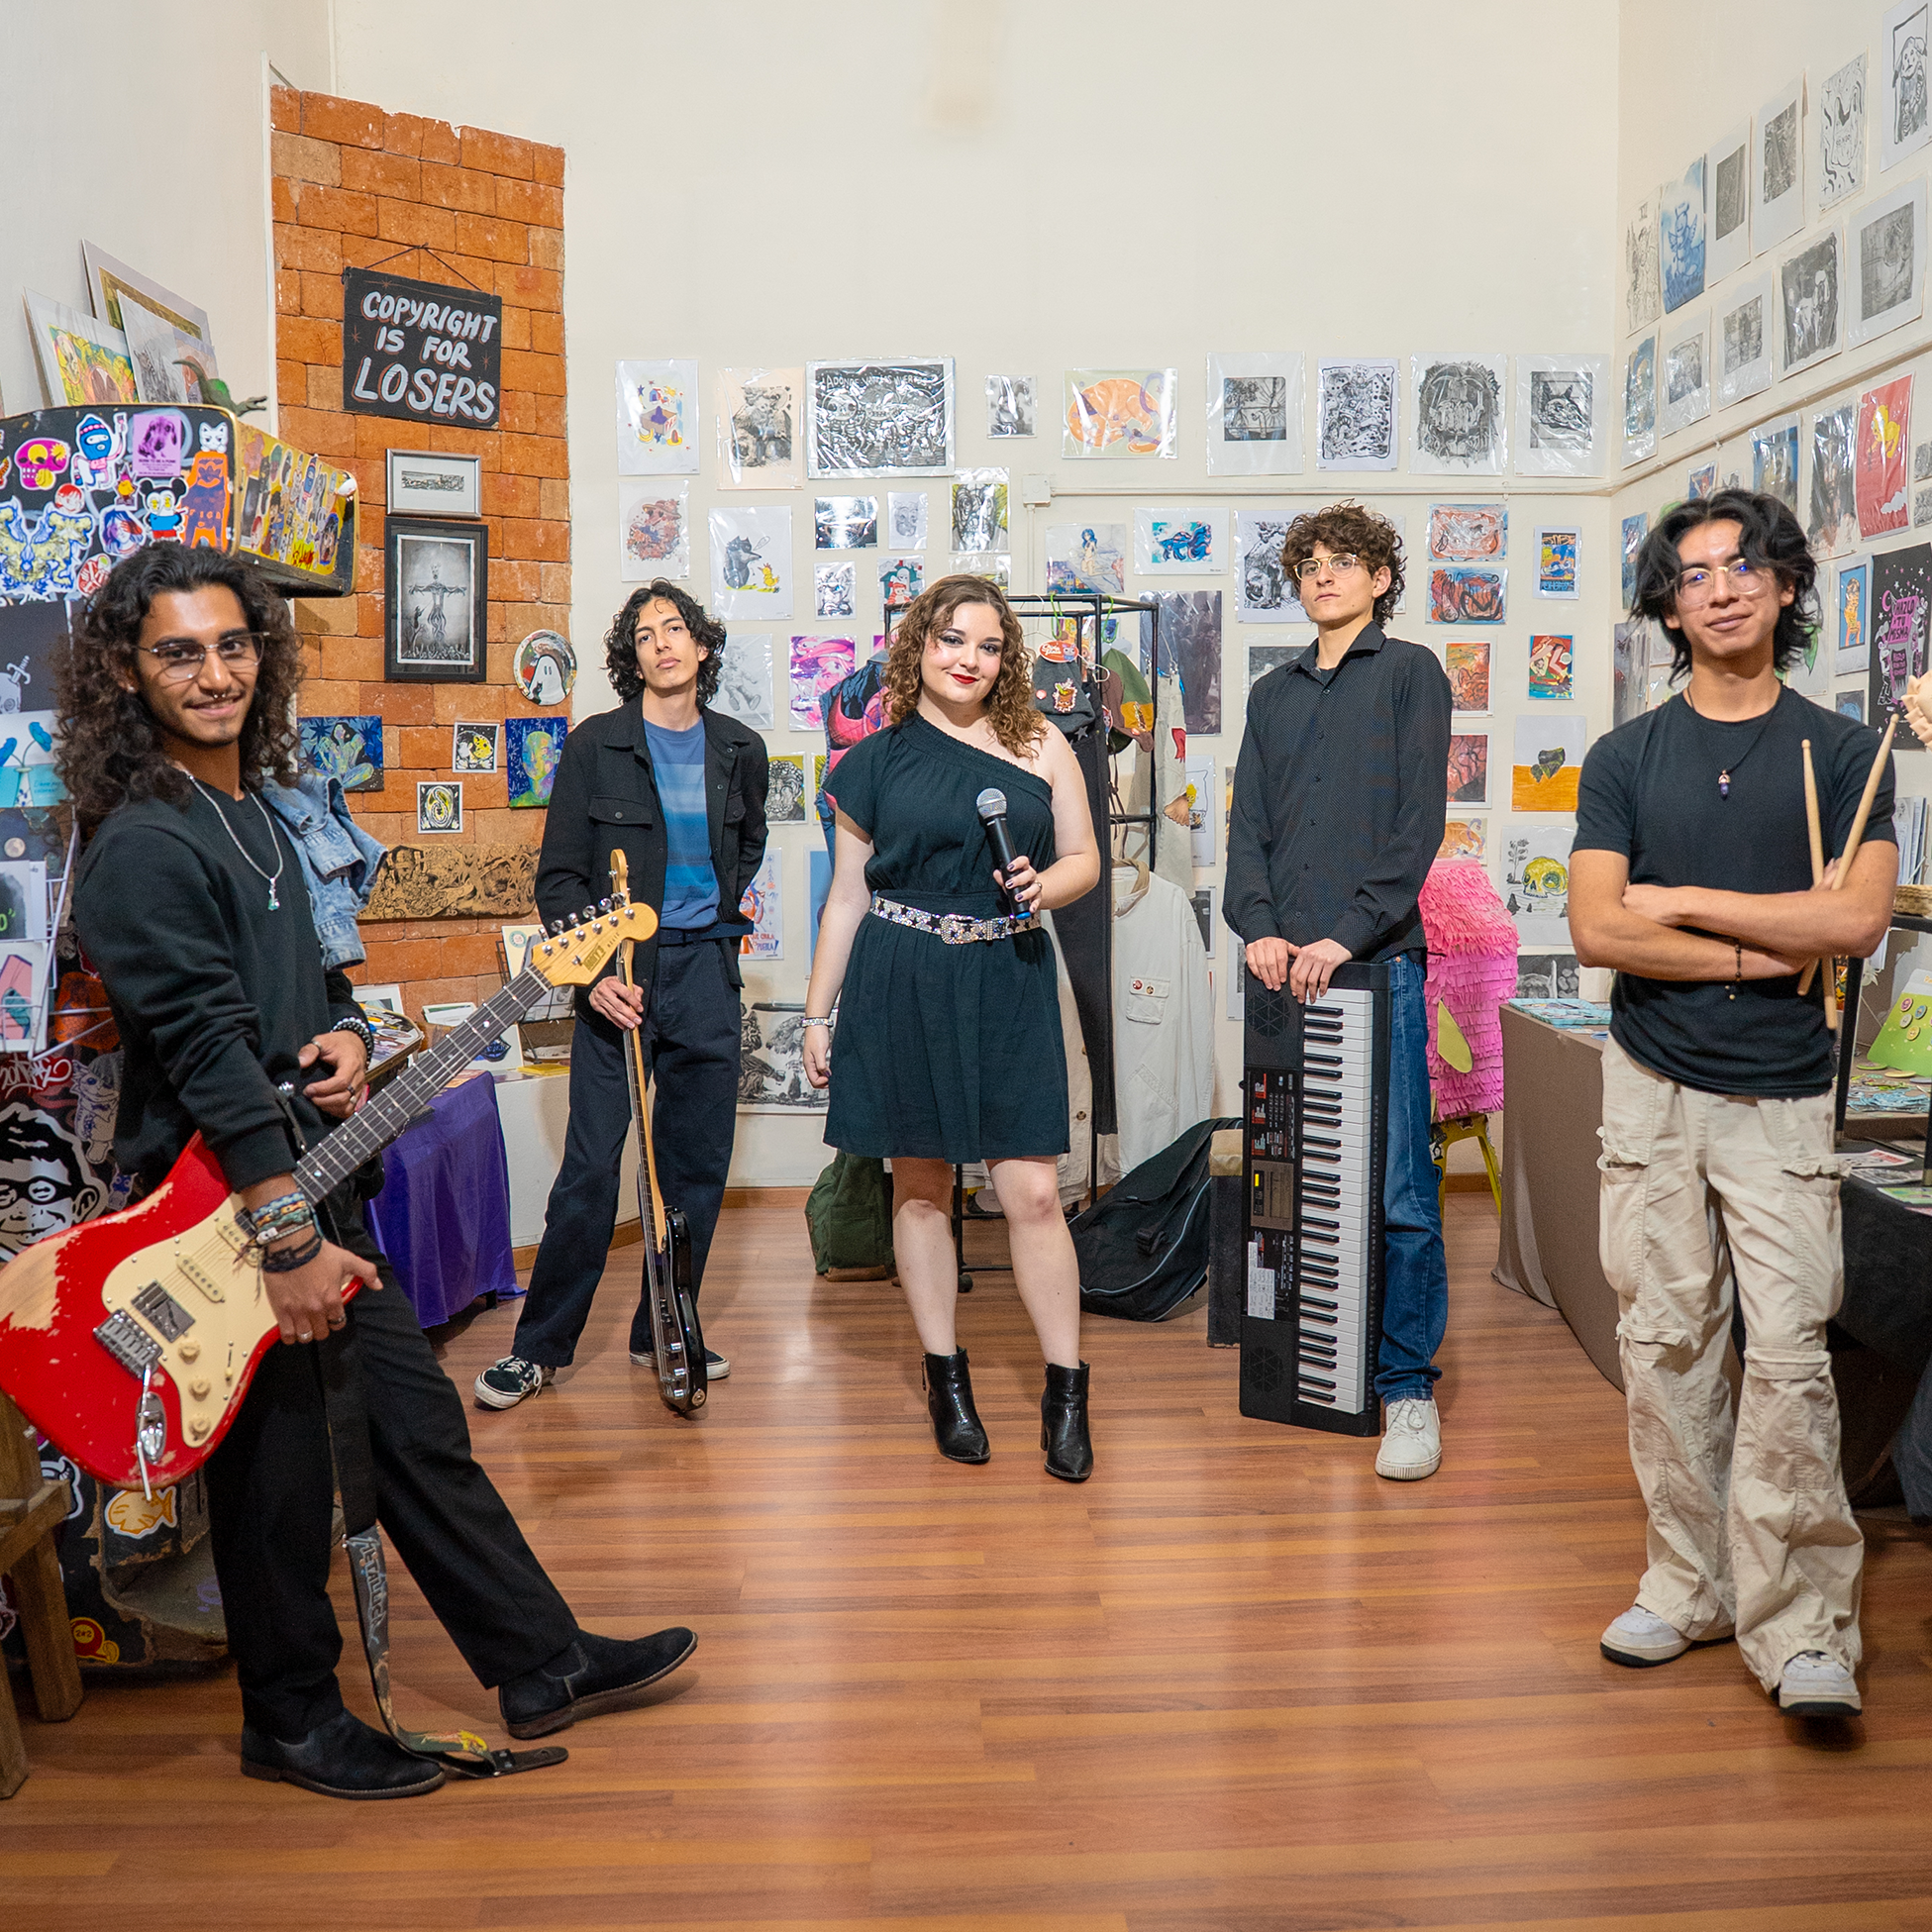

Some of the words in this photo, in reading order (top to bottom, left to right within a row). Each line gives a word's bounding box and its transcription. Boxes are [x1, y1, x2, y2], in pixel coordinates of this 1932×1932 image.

[361, 291, 498, 343] COPYRIGHT
[375, 326, 405, 353] IS
[421, 336, 472, 368] FOR
[353, 356, 496, 421] LOSERS
